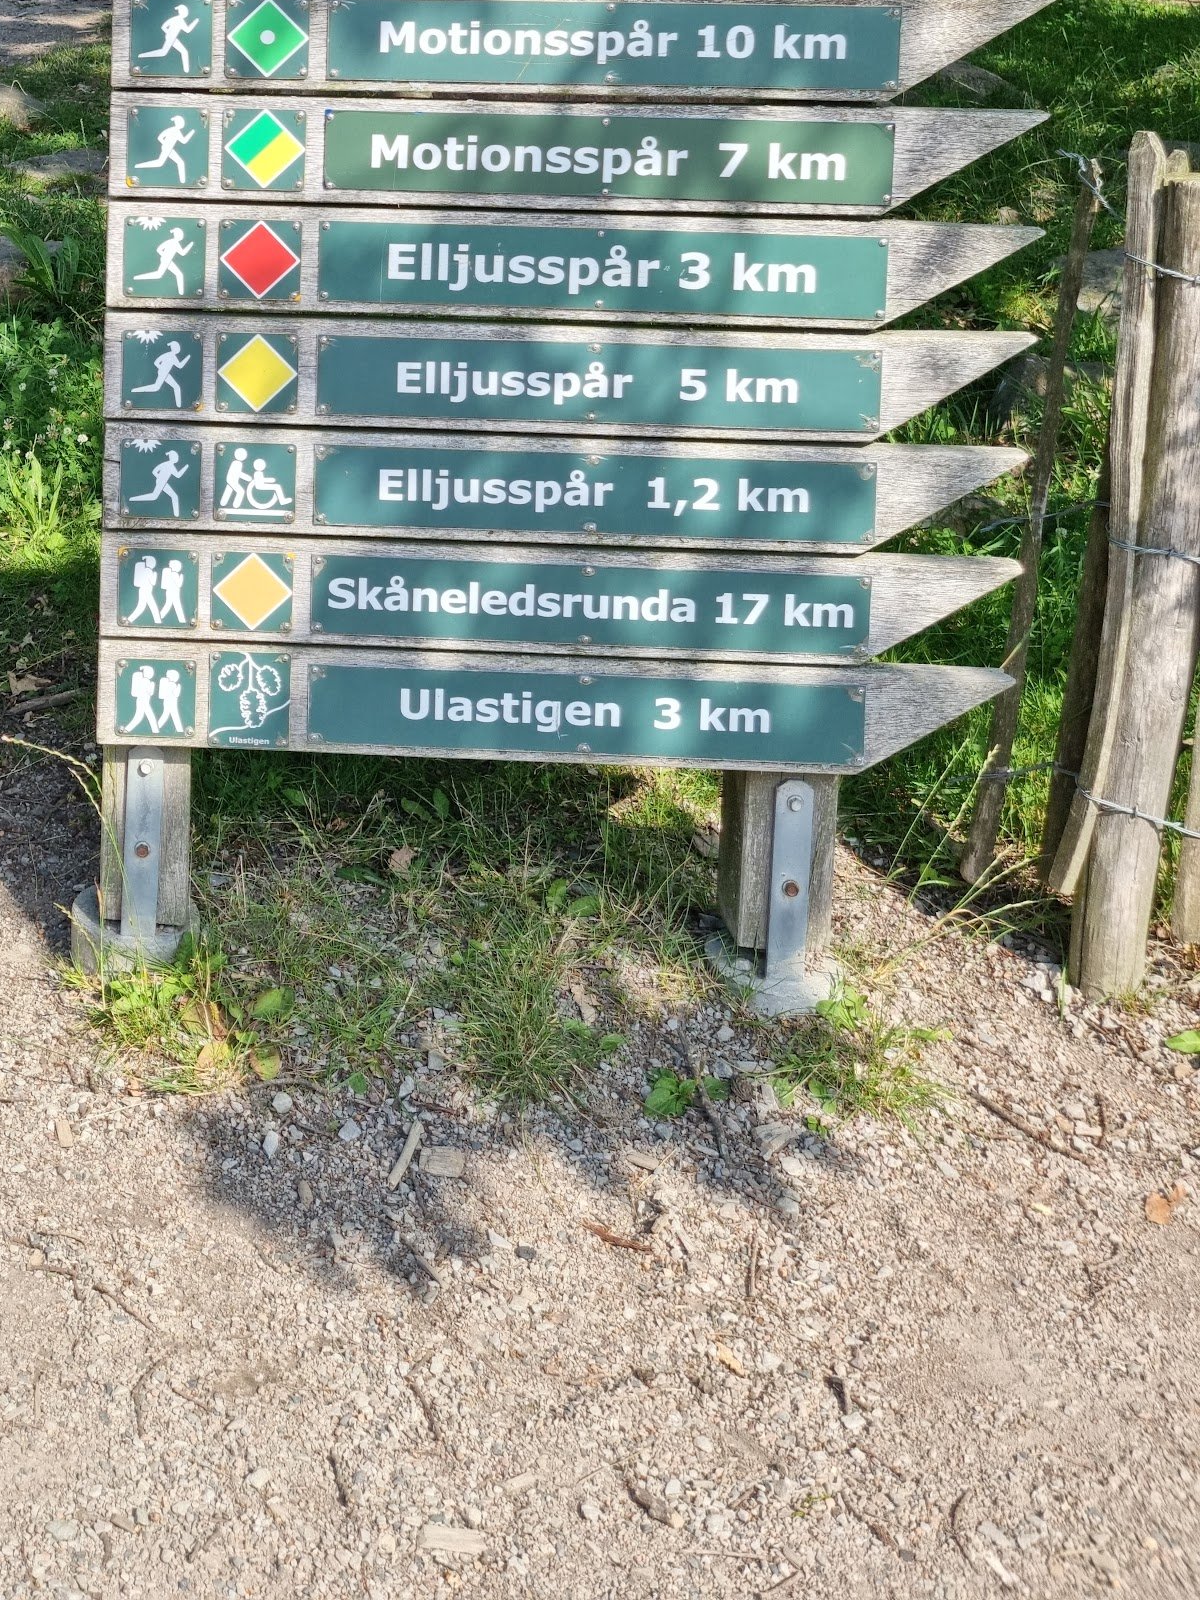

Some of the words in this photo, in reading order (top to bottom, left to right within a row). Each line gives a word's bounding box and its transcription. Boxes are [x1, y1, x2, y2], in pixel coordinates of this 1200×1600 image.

[380, 20, 677, 64] Motionsspår
[697, 25, 754, 58] 10
[774, 25, 846, 59] km
[371, 134, 688, 183] Motionsspår
[719, 143, 750, 177] 7
[768, 143, 846, 180] km
[388, 243, 660, 294] Elljusspår
[679, 252, 710, 289] 3
[734, 253, 816, 293] km
[398, 361, 633, 405] Elljusspår
[680, 369, 707, 401] 5
[726, 369, 799, 403] km
[379, 469, 613, 512] Elljusspår
[648, 477, 720, 516] 1,2
[738, 479, 810, 513] km
[328, 576, 695, 622] Skåneledsrunda
[716, 593, 769, 624] 17
[784, 594, 853, 628] km
[401, 688, 621, 732] Ulastigen
[654, 698, 681, 730] 3
[700, 698, 770, 733] km
[228, 736, 270, 746] Ulastigen
